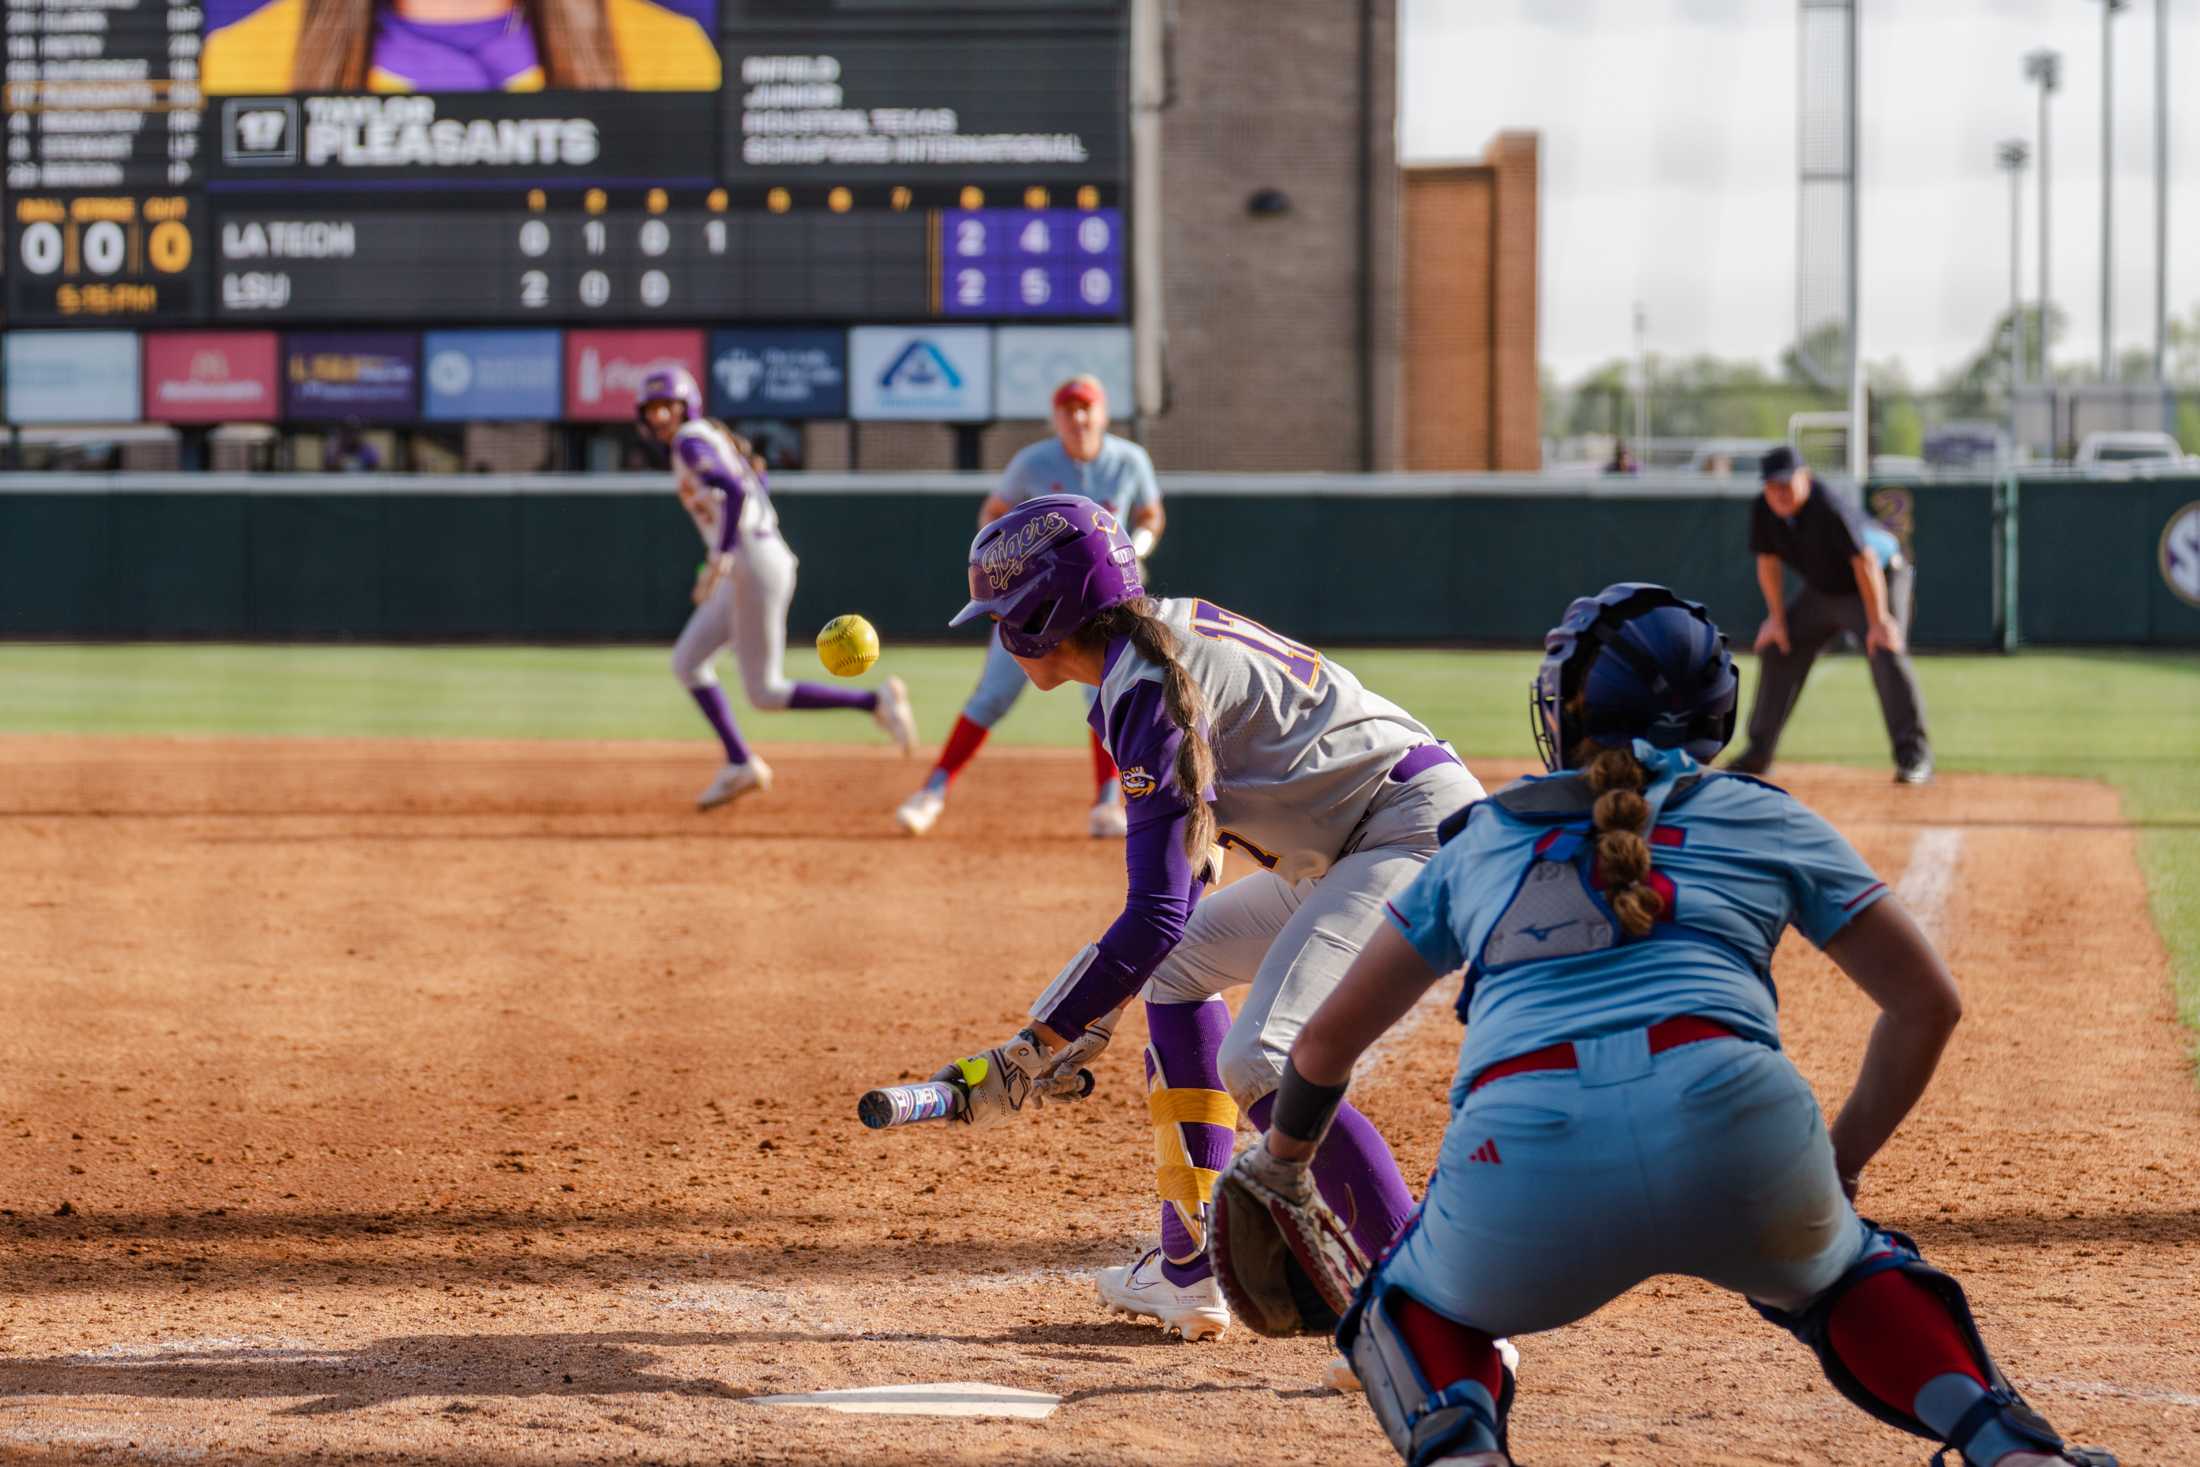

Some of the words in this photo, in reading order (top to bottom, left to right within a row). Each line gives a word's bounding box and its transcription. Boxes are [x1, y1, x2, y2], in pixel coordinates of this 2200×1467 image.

[237, 111, 287, 150] 17
[305, 119, 600, 166] PLEASANTS
[21, 222, 62, 275] 0
[83, 221, 125, 275] 0
[149, 220, 193, 274] 0
[222, 222, 268, 258] LA
[519, 220, 550, 257] 0
[582, 220, 607, 256] 1
[706, 219, 728, 255] 1
[956, 218, 987, 257] 2
[1018, 219, 1052, 254] 4
[222, 271, 291, 309] LSU
[520, 269, 549, 308] 2
[956, 267, 987, 306] 2
[982, 511, 1068, 590] Tigers
